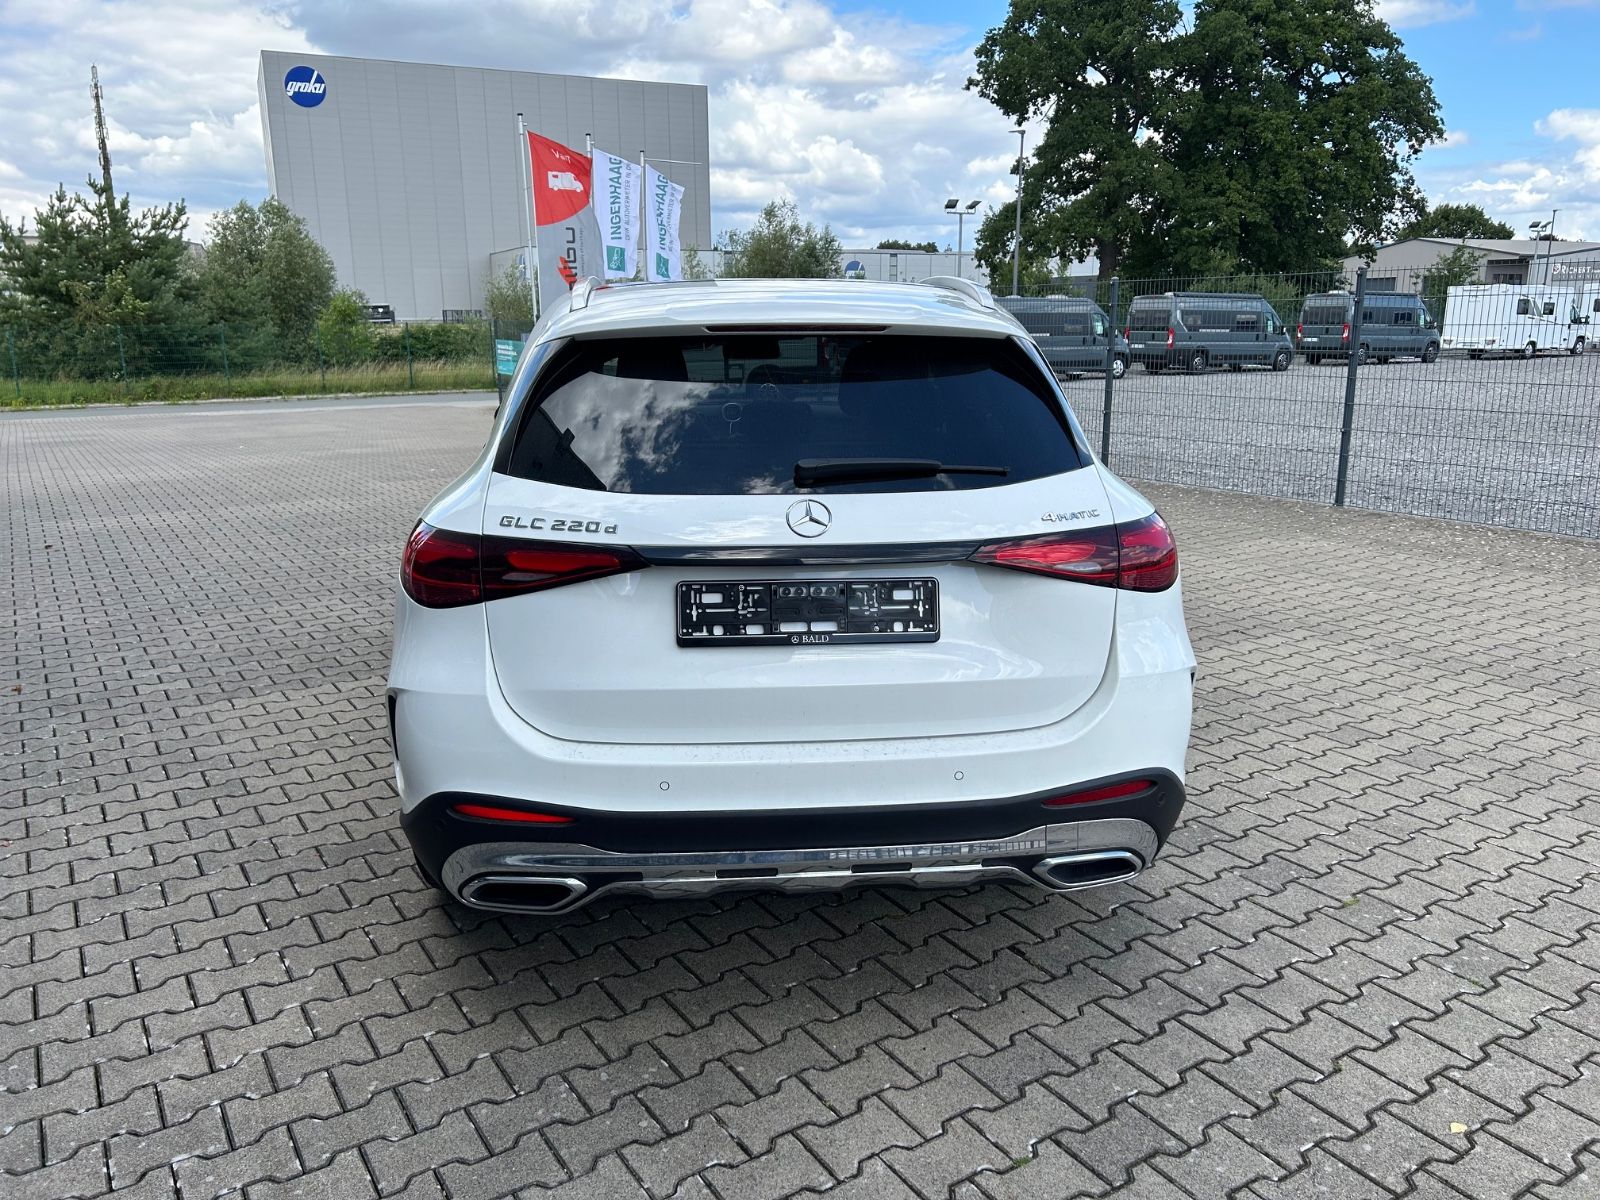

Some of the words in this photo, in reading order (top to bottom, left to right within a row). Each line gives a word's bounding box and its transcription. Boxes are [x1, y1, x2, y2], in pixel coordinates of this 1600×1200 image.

[286, 70, 326, 96] groku
[608, 156, 623, 241] INGENHAAG
[499, 515, 546, 530] GLC
[1041, 508, 1100, 523] 4MATIC
[802, 634, 829, 643] BALD
